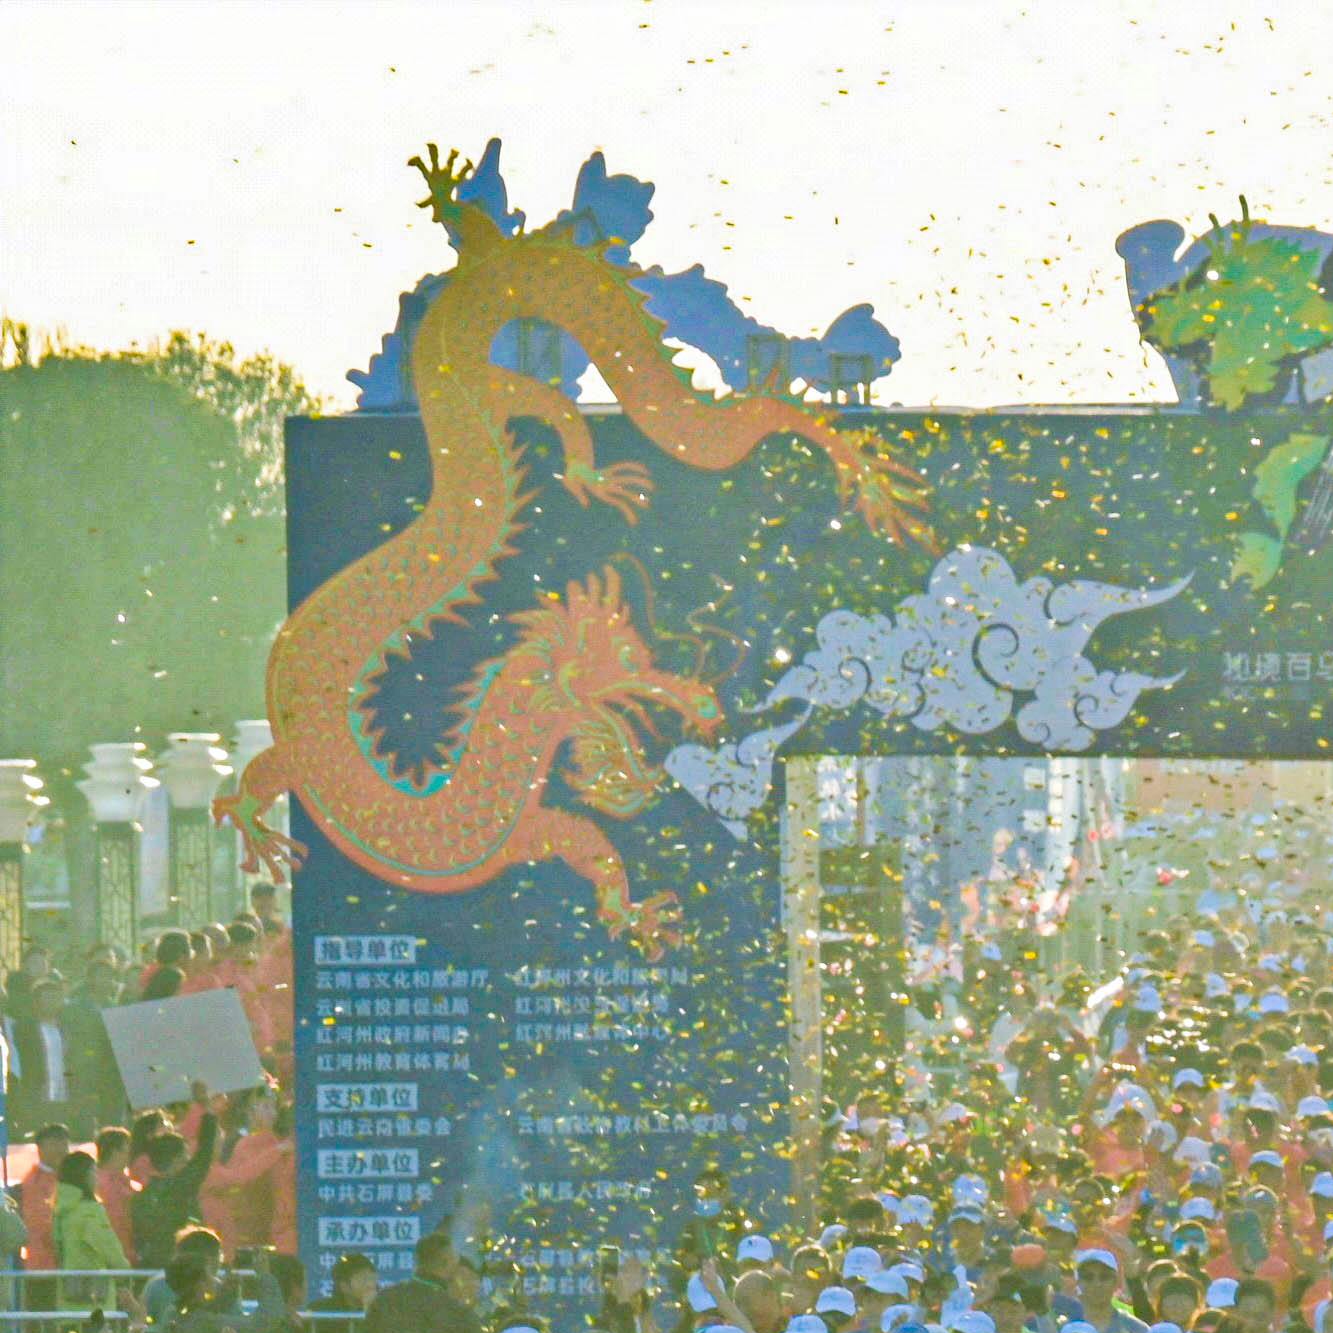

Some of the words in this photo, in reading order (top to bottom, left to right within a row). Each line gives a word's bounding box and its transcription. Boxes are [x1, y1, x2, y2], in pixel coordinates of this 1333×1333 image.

[325, 1152, 411, 1174] 主办单位
[327, 1220, 412, 1241] 承办单位
